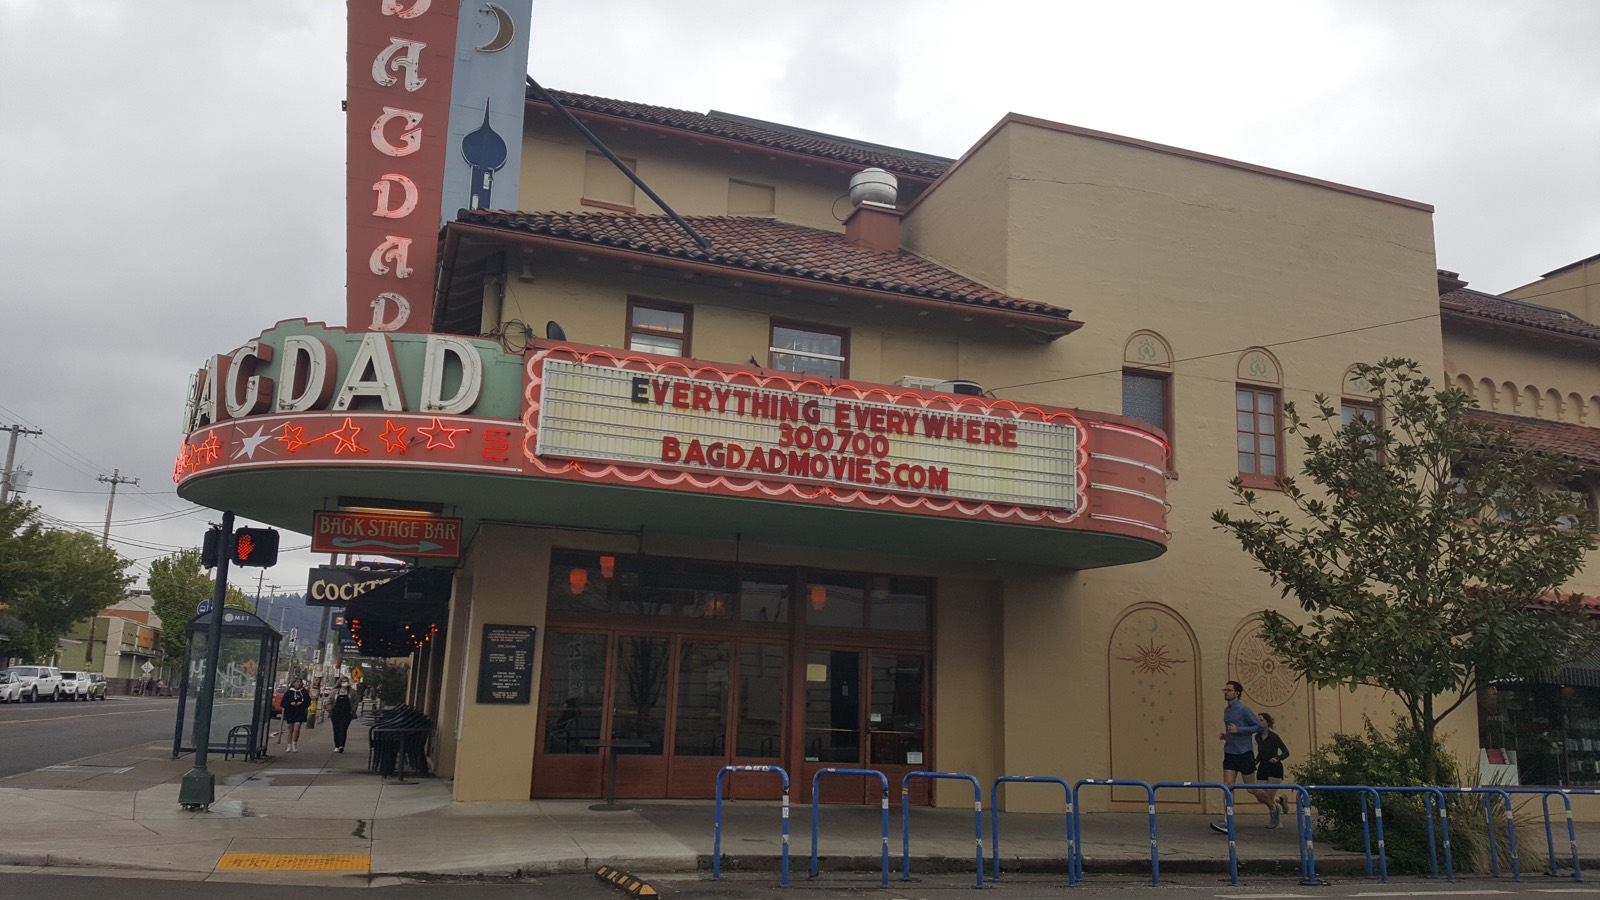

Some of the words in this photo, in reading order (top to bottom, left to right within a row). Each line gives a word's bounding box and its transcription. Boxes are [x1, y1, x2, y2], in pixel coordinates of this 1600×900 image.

[631, 376, 821, 426] EVERYTHING
[834, 403, 1018, 448] EVERYWHERE
[661, 435, 949, 491] BAGDADMOVIESCOM
[368, 519, 419, 538] STAGE
[424, 522, 456, 541] BAR
[311, 578, 391, 601] COCKT
